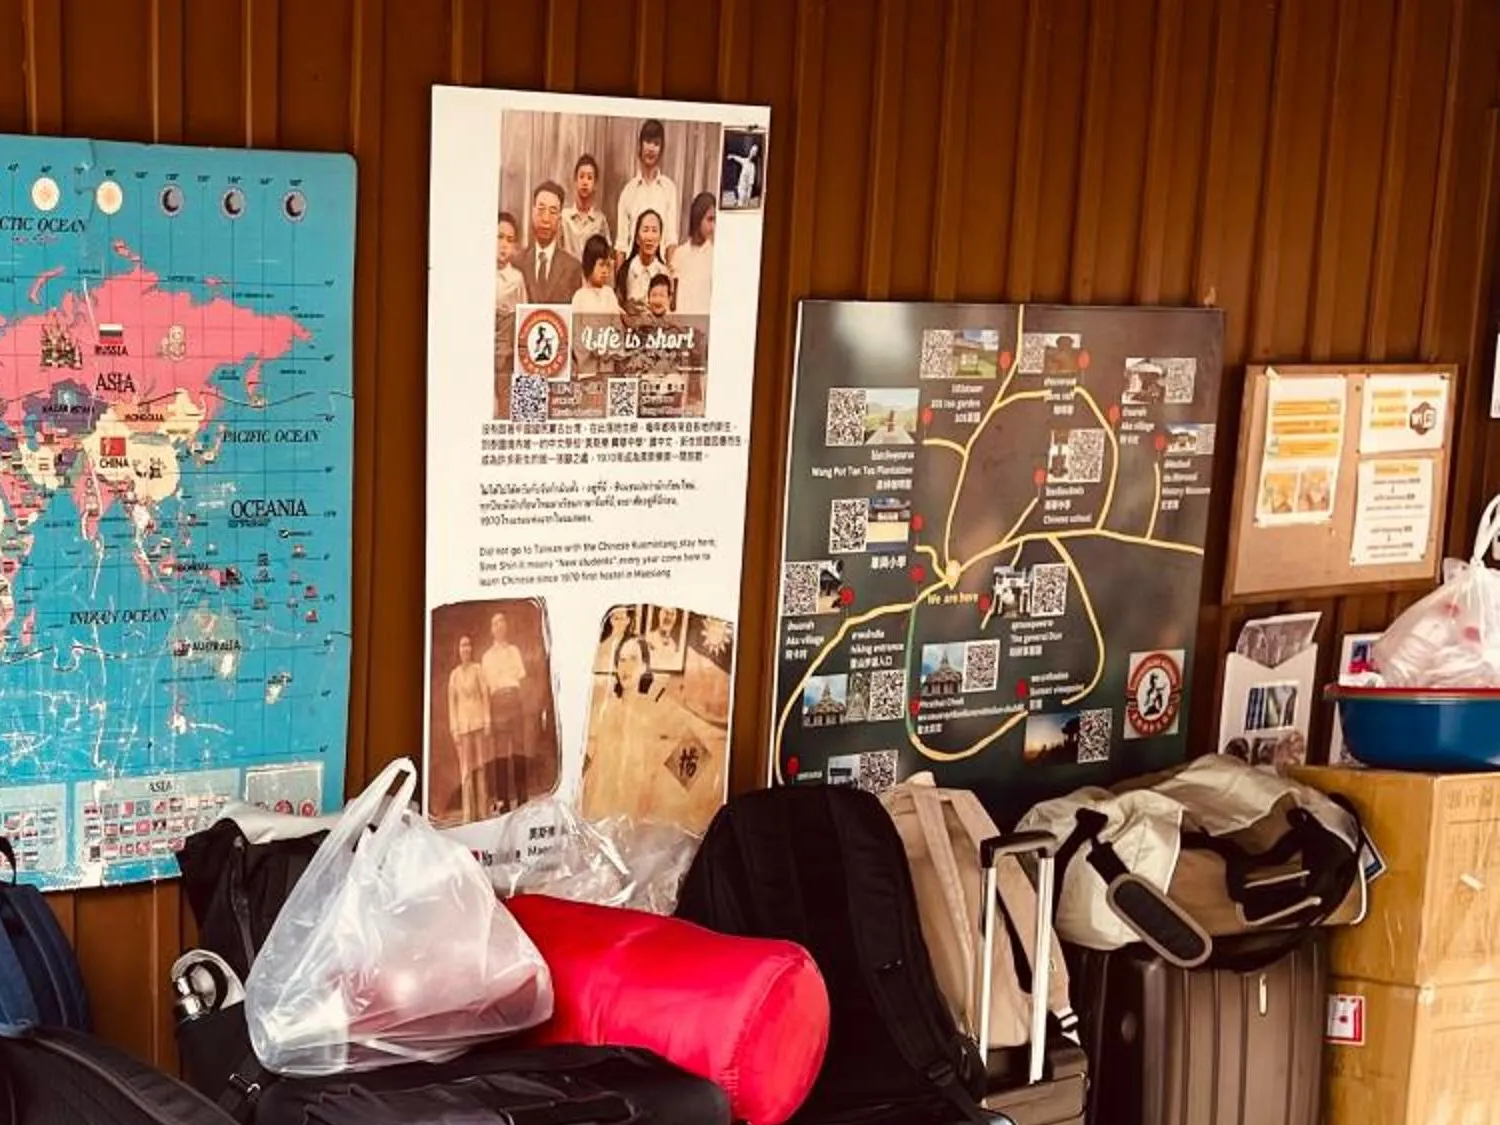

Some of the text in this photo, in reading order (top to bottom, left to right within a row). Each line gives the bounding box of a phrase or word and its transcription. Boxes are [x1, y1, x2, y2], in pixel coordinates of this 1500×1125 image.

[581, 325, 695, 355] Life is short
[96, 372, 135, 393] ASIA
[100, 458, 130, 469] CHINA
[231, 499, 308, 518] OCEANIA
